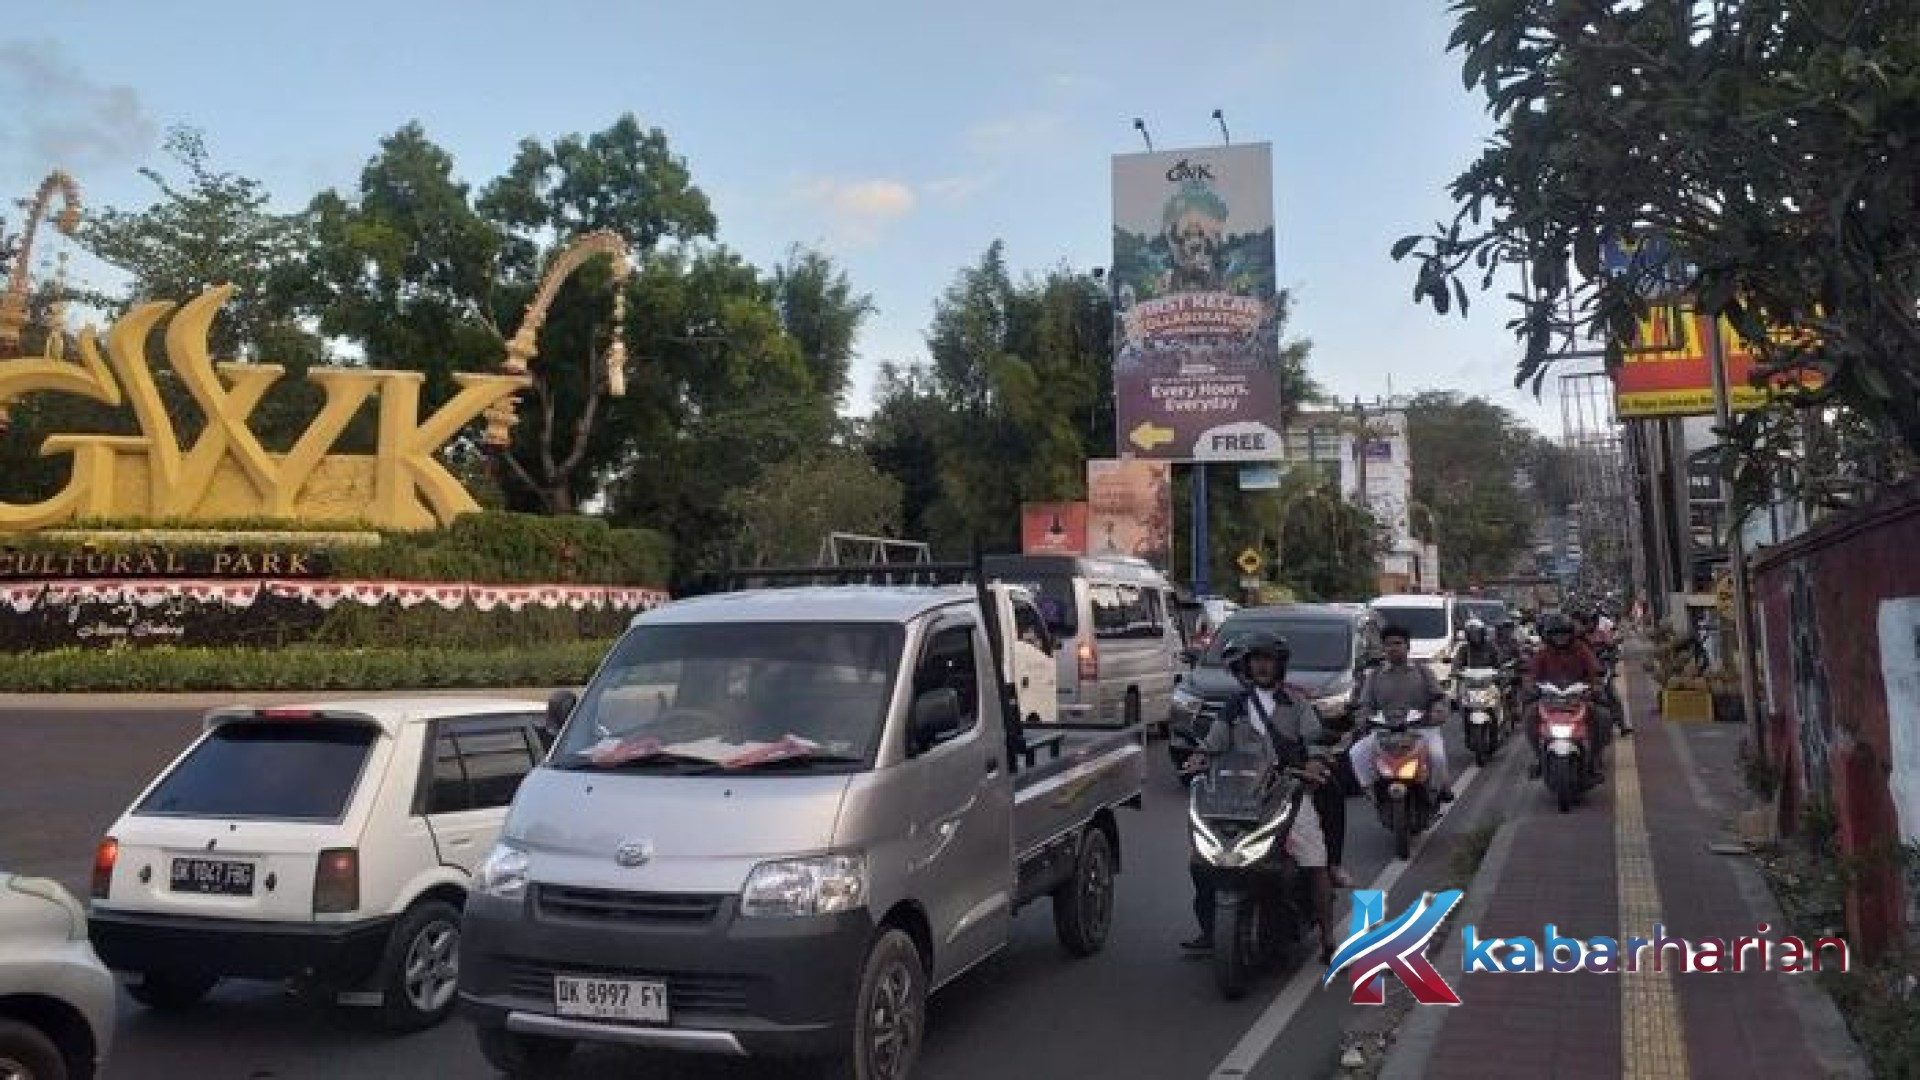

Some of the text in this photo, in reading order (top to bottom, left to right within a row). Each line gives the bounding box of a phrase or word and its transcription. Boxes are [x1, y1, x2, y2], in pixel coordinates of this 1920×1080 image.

[1151, 384, 1195, 400] Every
[1165, 397, 1238, 412] Everyday
[1212, 432, 1266, 451] FREE
[213, 552, 310, 575] PARK
[559, 980, 664, 1009] DK 8997 FY
